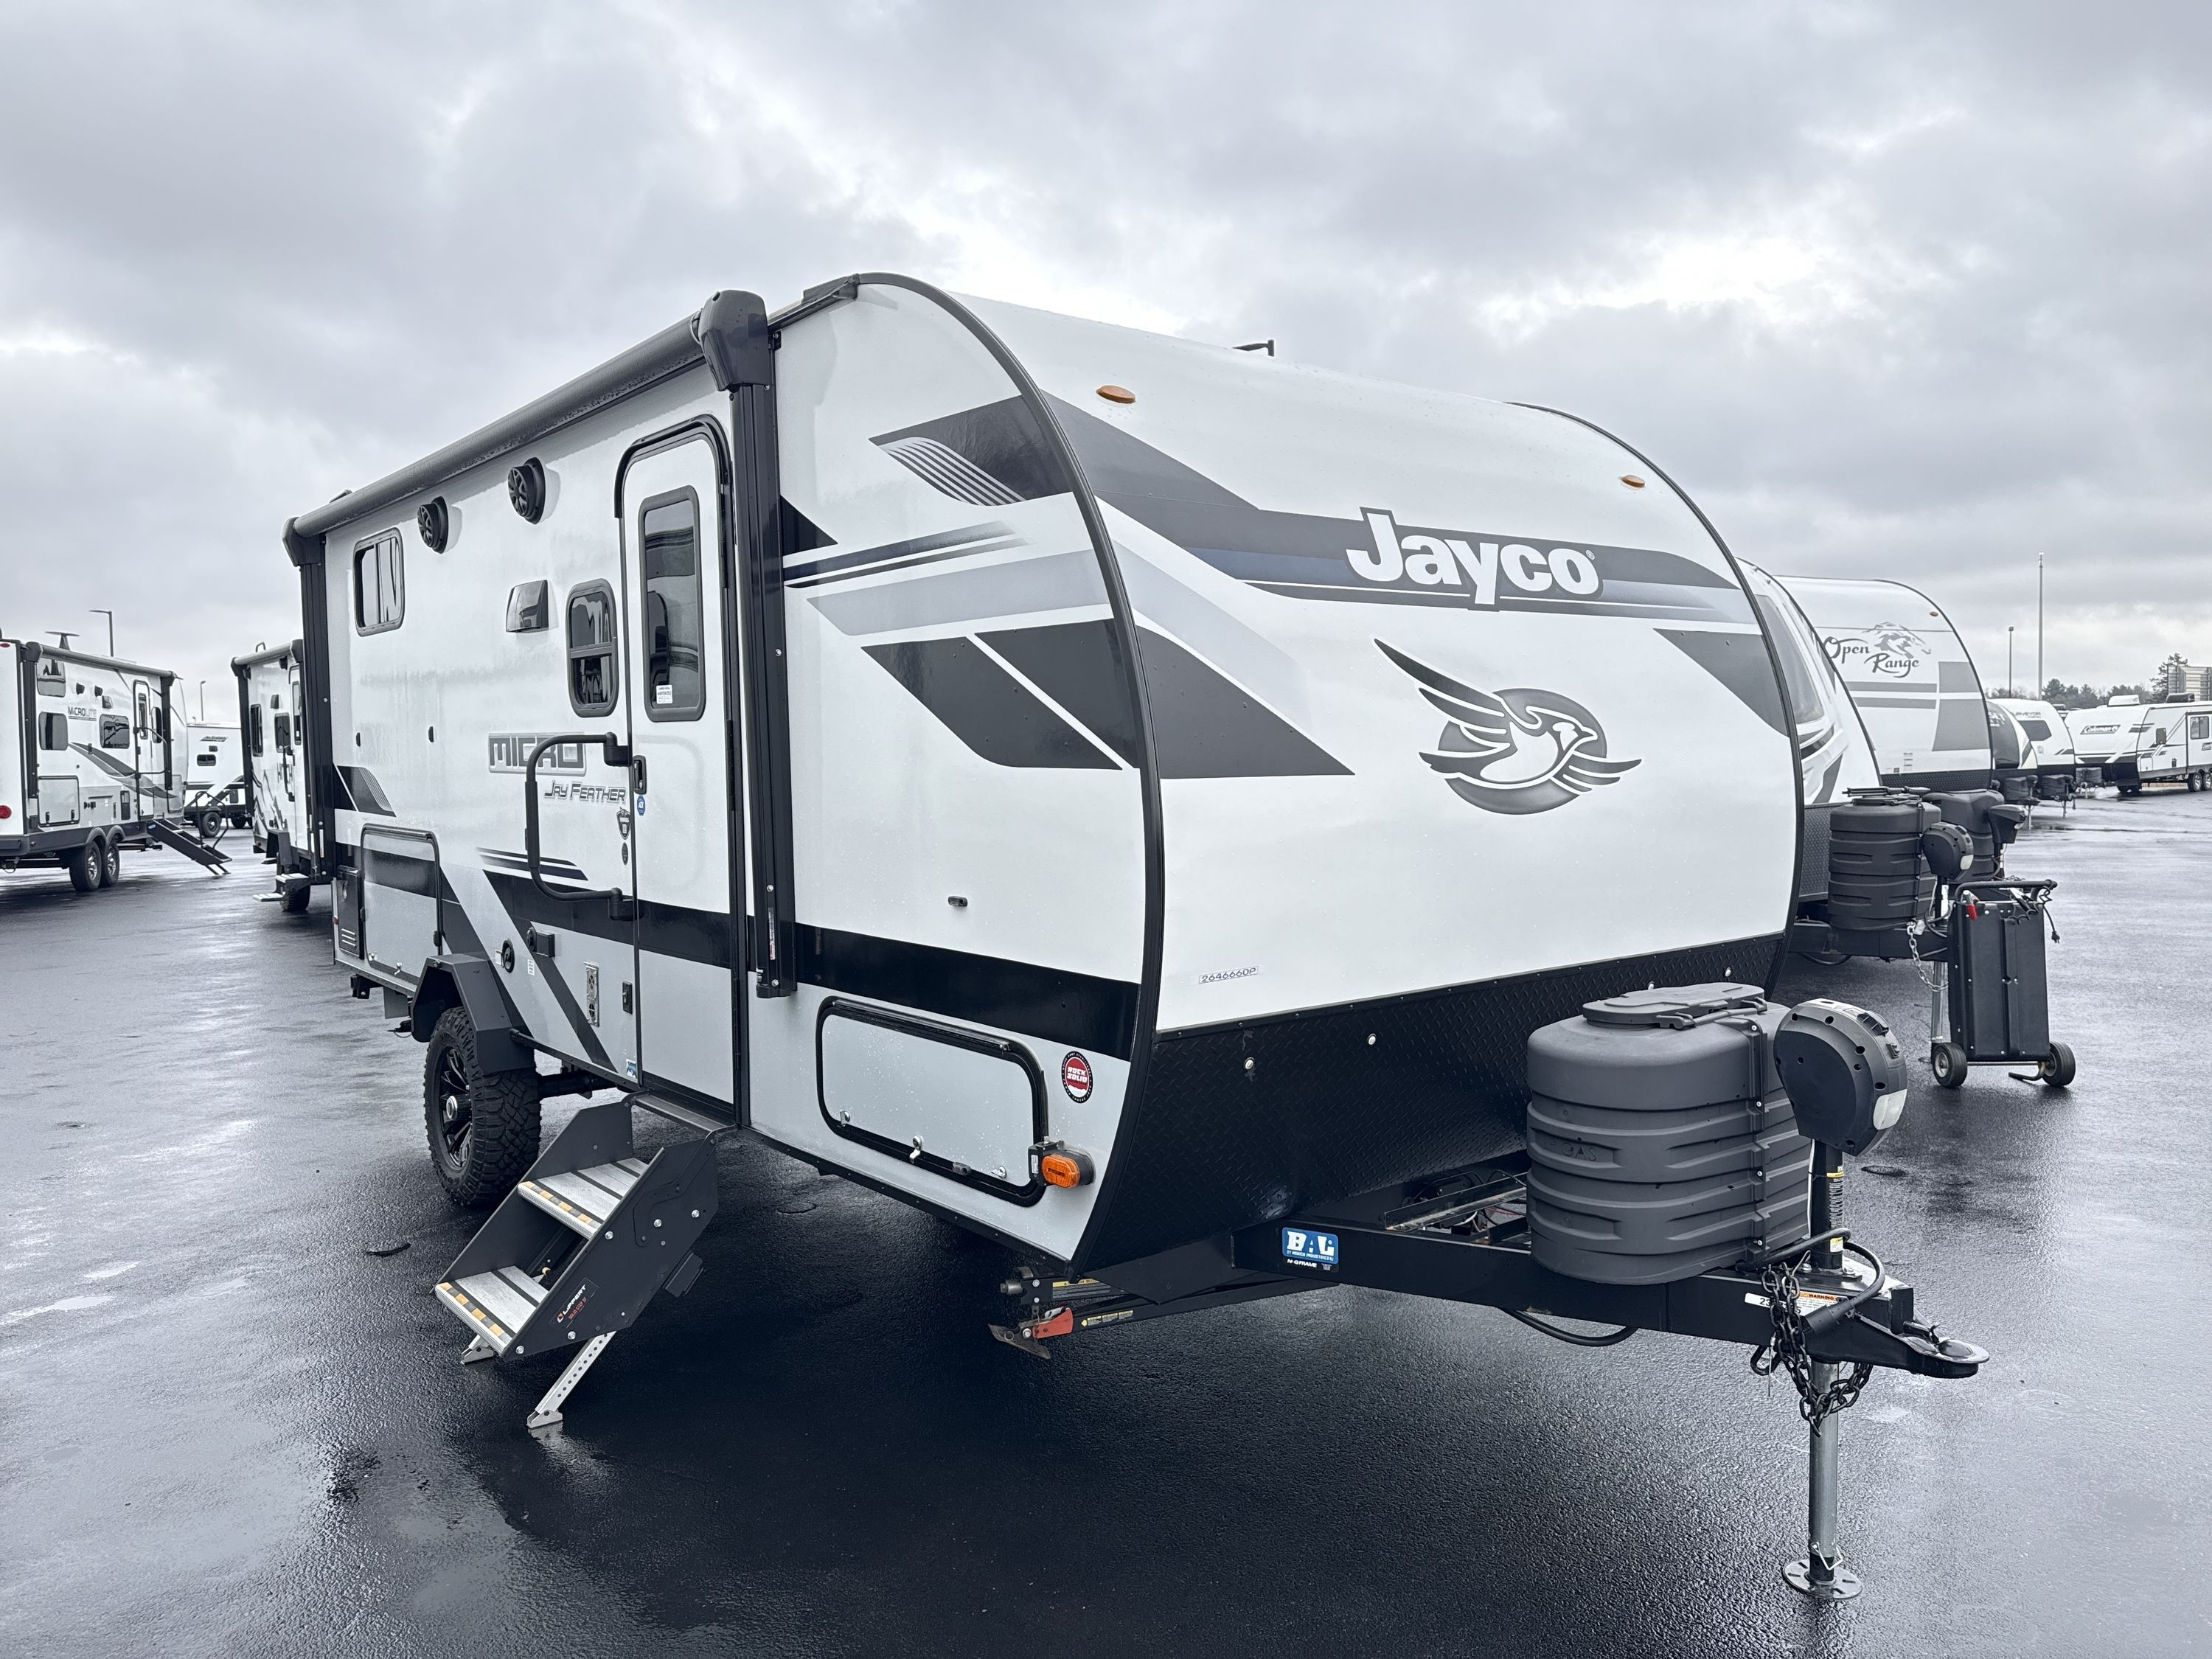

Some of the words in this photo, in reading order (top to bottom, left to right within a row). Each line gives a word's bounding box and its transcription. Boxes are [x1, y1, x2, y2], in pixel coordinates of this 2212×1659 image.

[1346, 512, 1599, 605] Jayco
[1823, 636, 1870, 664] Open
[1864, 653, 1919, 678] Range
[571, 783, 626, 801] FEATHER
[1202, 967, 1256, 983] 2646660P
[1067, 1073, 1088, 1083] SOLID
[1068, 1066, 1086, 1076] ROCK
[1287, 1231, 1334, 1256] BAL
